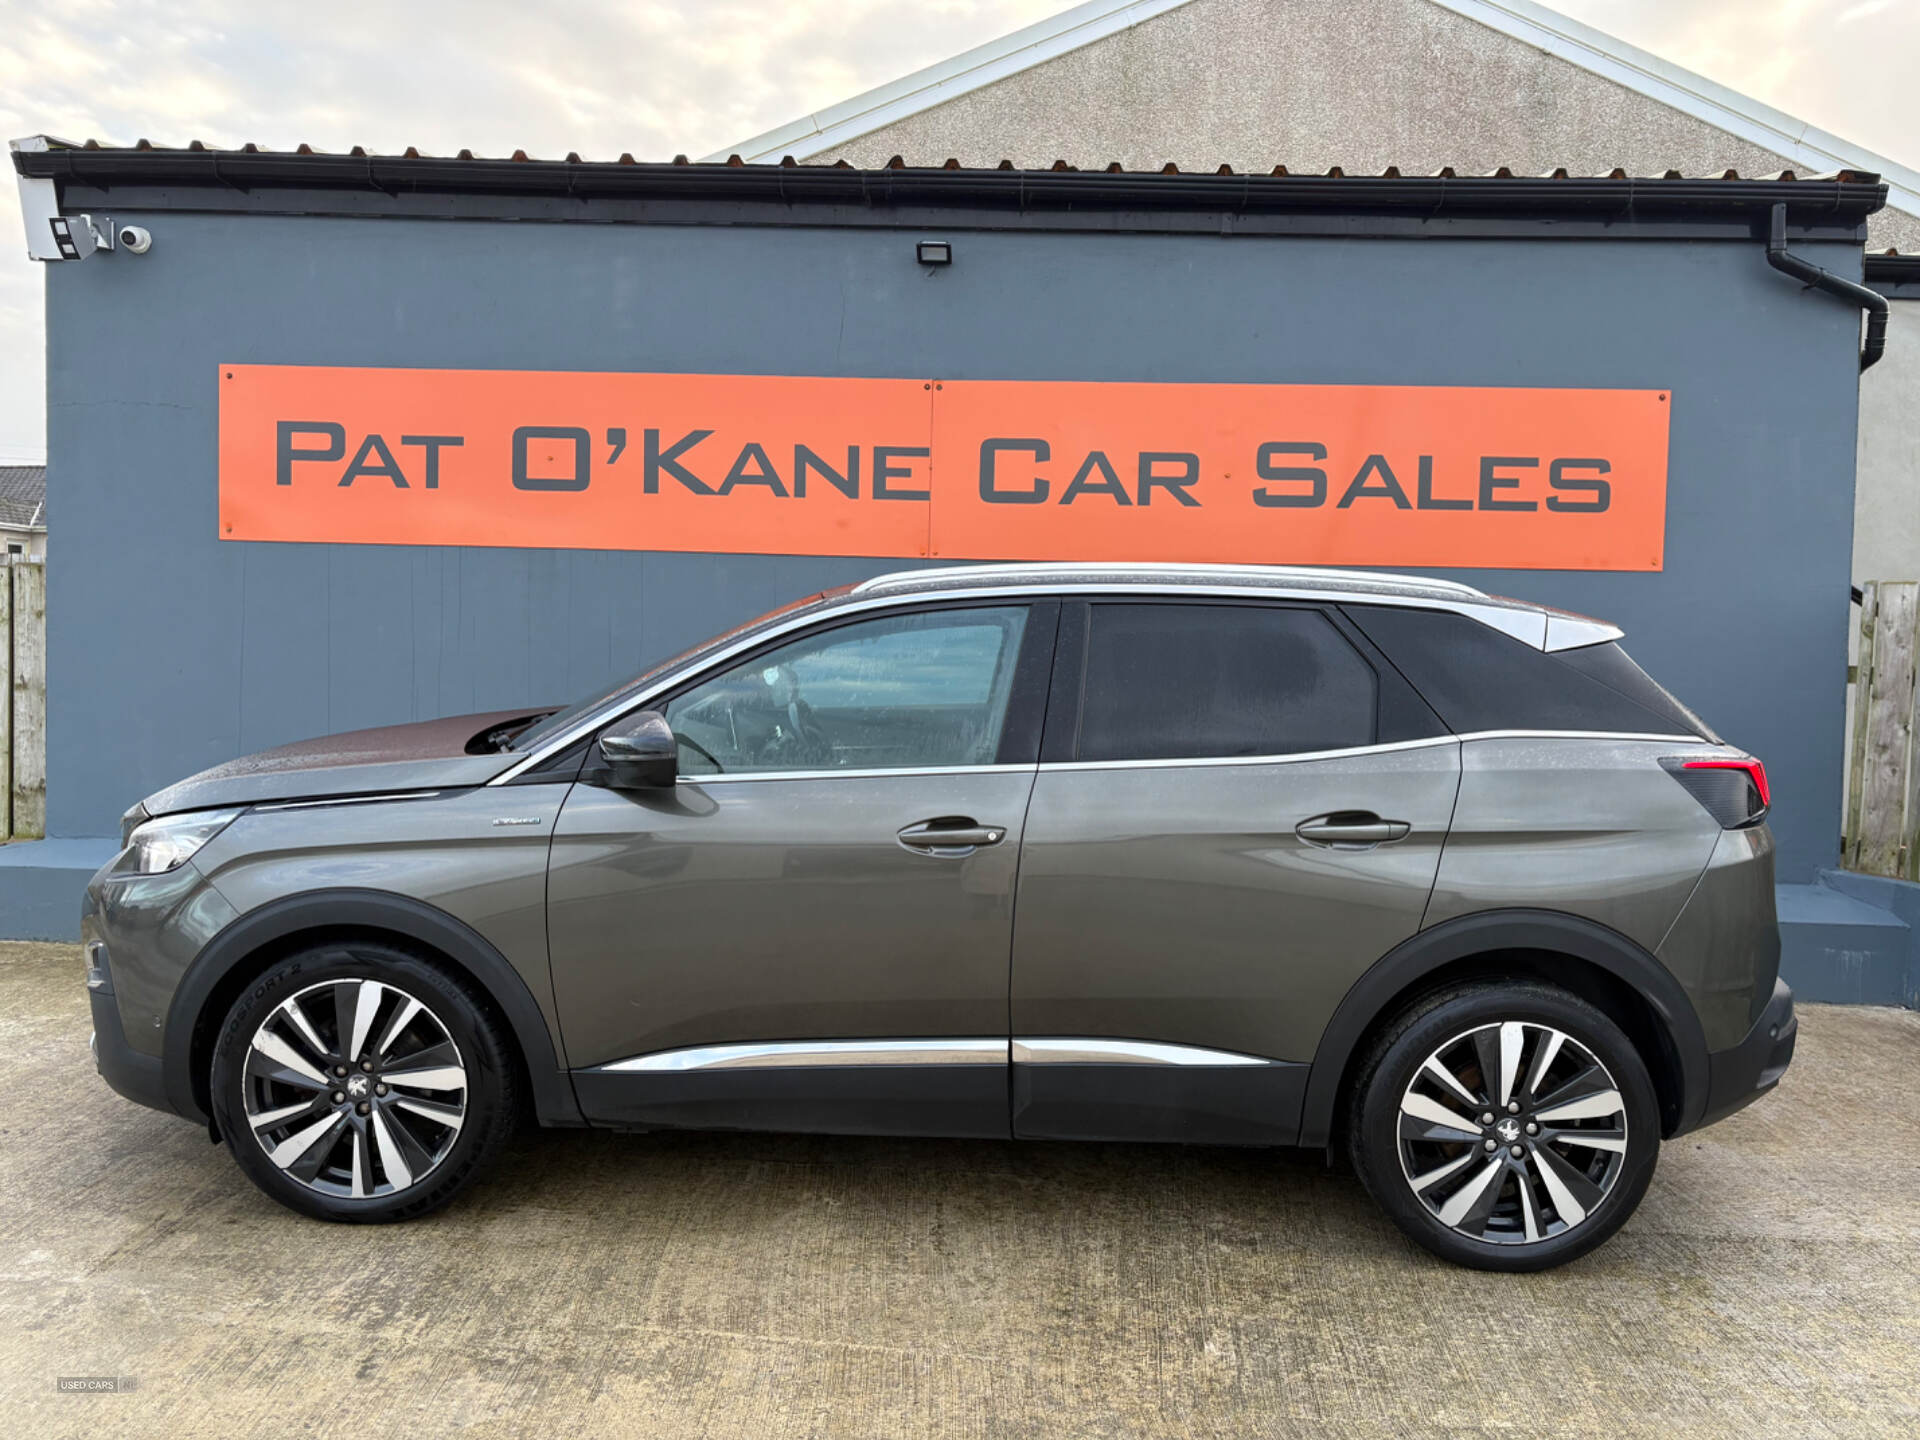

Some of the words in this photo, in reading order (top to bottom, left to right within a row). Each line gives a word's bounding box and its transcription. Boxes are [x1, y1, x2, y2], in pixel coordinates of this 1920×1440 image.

[277, 421, 464, 488] PAT
[512, 426, 930, 501] O'KANE
[979, 438, 1202, 506] CAR
[1252, 442, 1611, 512] SALES
[291, 962, 302, 975] 2
